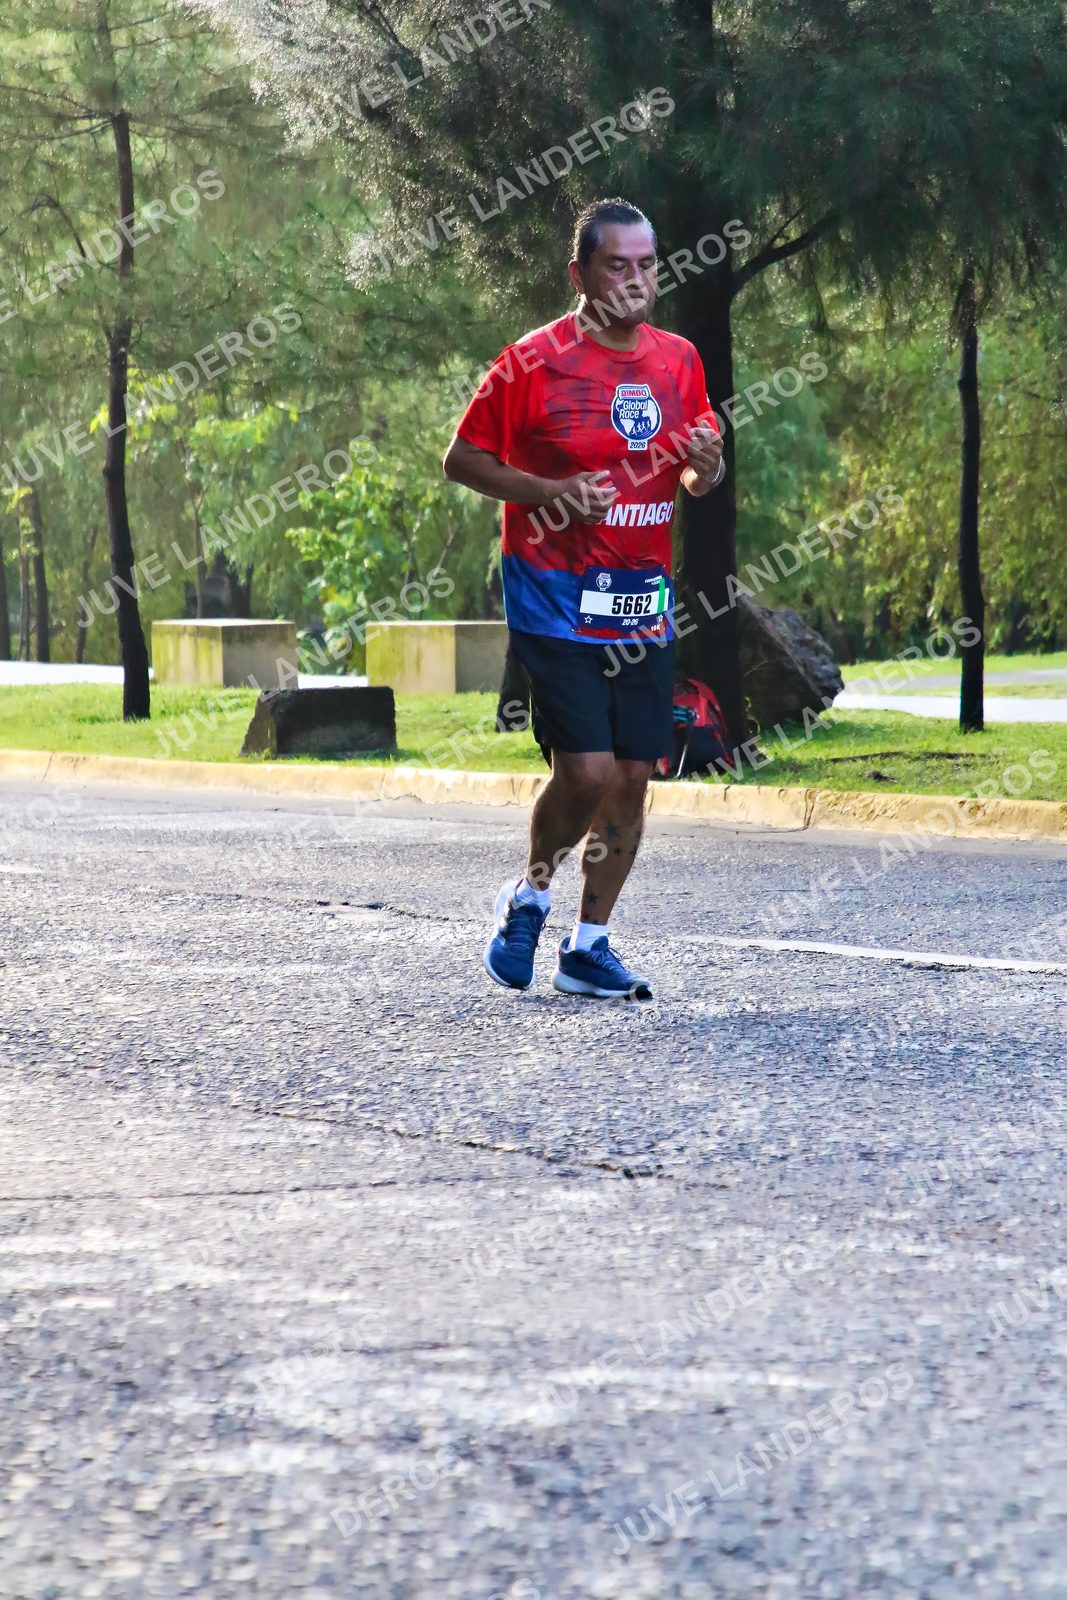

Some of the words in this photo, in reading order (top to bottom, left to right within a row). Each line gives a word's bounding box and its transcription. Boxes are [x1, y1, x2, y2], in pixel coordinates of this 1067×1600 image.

[620, 389, 647, 397] BIMBO
[623, 400, 648, 410] Global
[619, 409, 640, 419] Race
[630, 441, 646, 449] 2026
[611, 594, 652, 615] 5662
